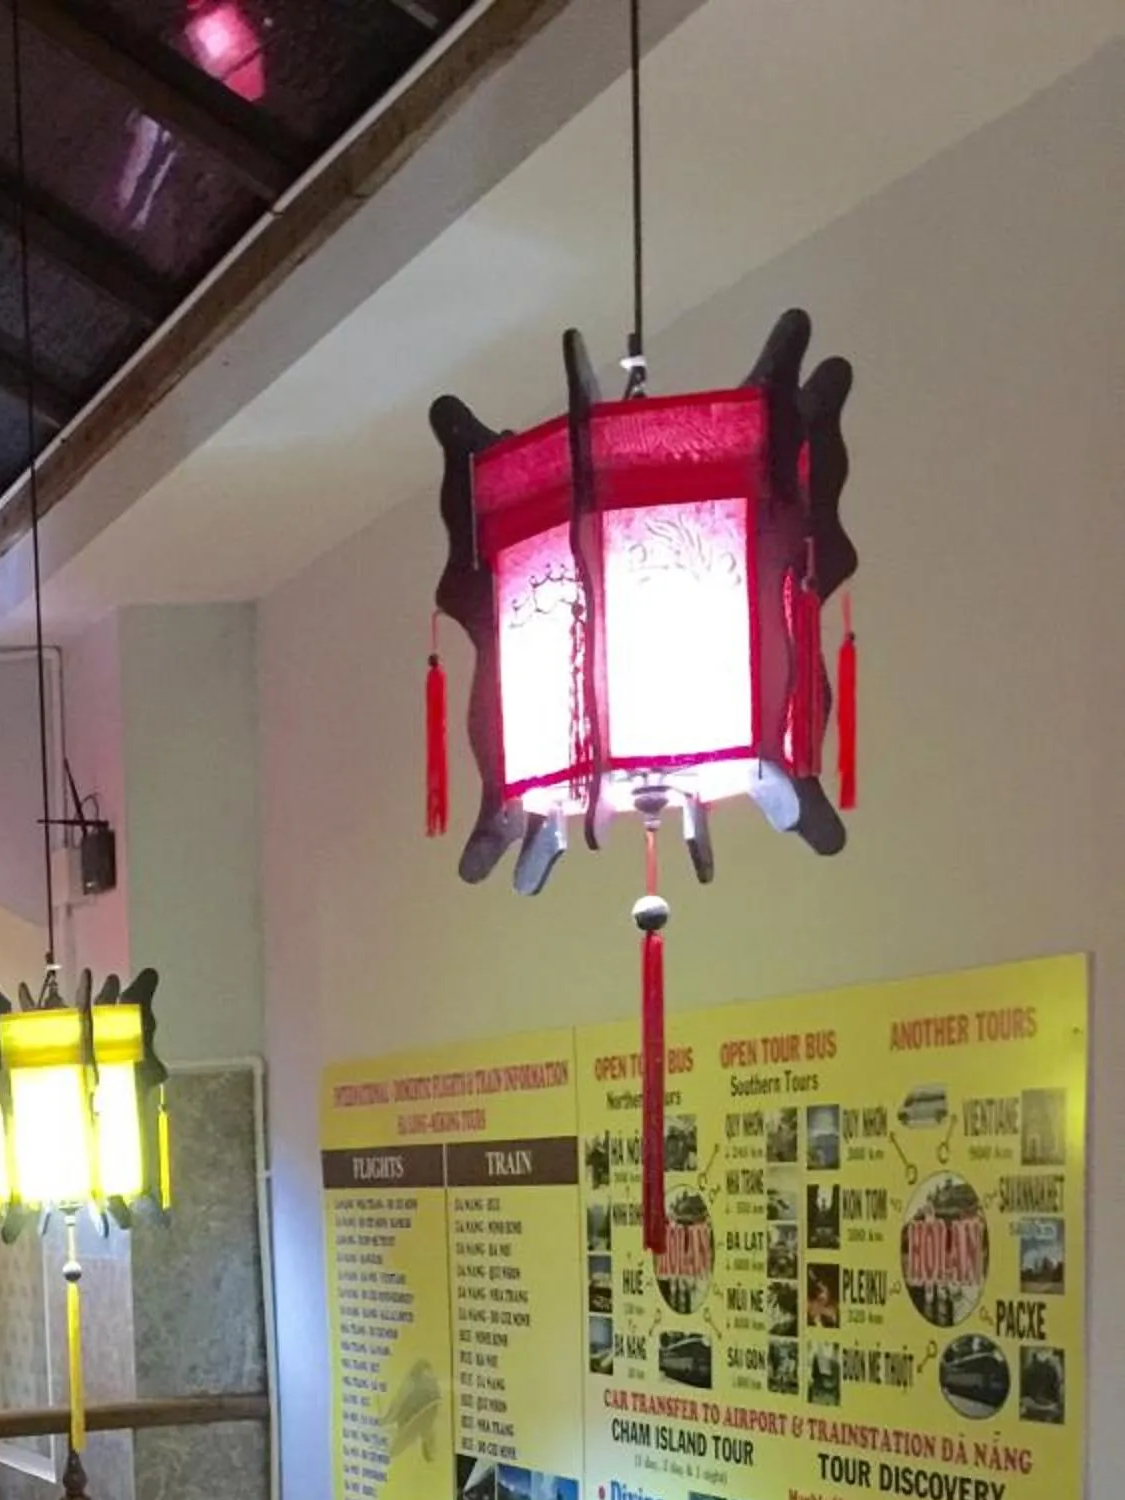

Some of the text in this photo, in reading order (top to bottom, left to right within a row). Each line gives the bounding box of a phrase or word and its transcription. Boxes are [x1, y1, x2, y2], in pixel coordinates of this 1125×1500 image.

[890, 1005, 1037, 1051] ANOTHER TOURS
[594, 1046, 693, 1081] OPEN BUS
[720, 1029, 837, 1069] OPEN TOUR BUS
[730, 1068, 818, 1096] Southern Tours
[352, 1155, 403, 1179] FLIGHTS
[486, 1149, 531, 1176] TRAIN
[996, 1300, 1046, 1339] PACXE
[604, 1388, 627, 1411] CAR
[632, 1392, 697, 1421] TRANSFER
[703, 1402, 719, 1425] TO
[722, 1404, 787, 1436] AIRPORT
[808, 1417, 935, 1459] TRAINSTATION
[611, 1417, 753, 1466] CHAM ISLAND TOUR
[818, 1452, 871, 1489] TOUR
